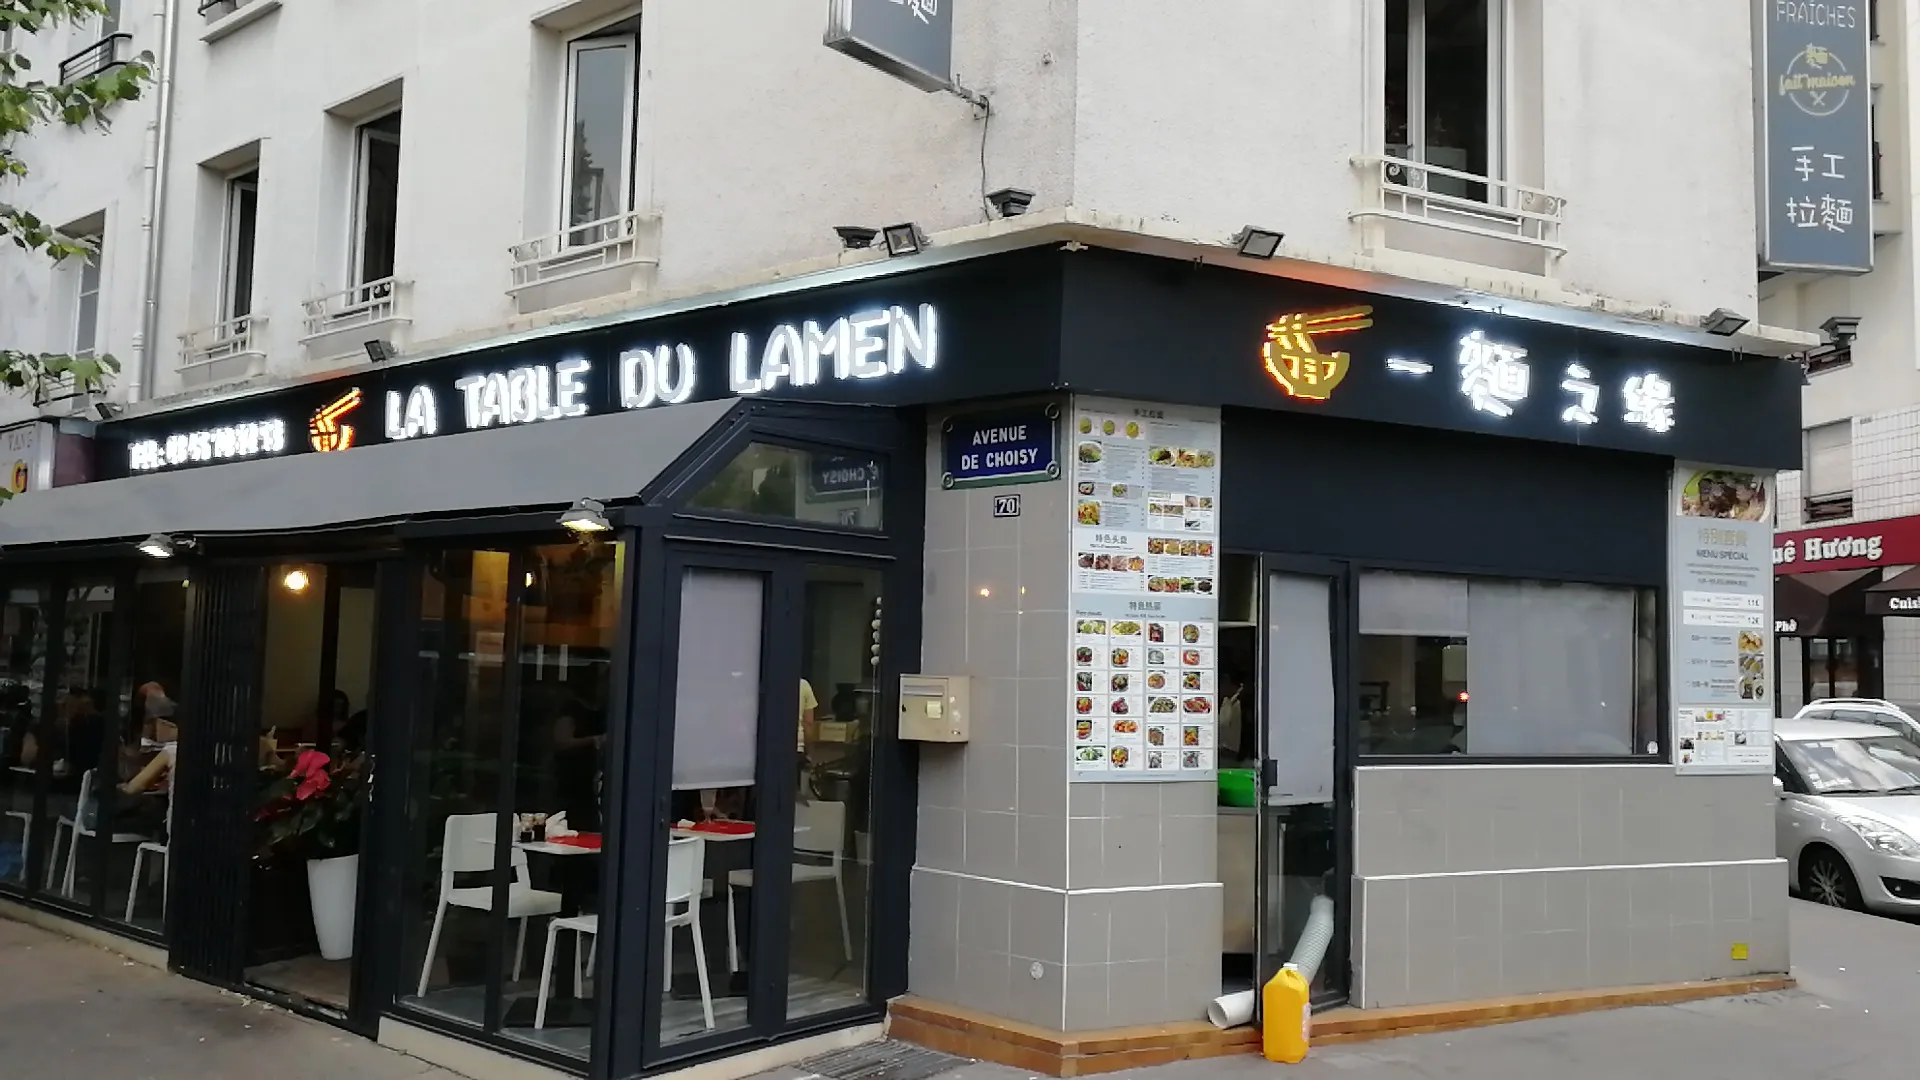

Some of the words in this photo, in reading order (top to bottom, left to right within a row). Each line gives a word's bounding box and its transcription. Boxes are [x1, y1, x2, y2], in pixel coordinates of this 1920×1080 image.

[1791, 145, 1845, 182] 手工
[1786, 193, 1853, 233] 拉麵
[384, 383, 437, 440] LA
[455, 359, 592, 430] TABLE
[619, 341, 696, 409] DU
[729, 302, 939, 395] LAMEN
[972, 425, 1027, 446] AVENUE
[961, 454, 979, 471] DE
[986, 447, 1039, 468] CHOISY
[998, 498, 1016, 514] 70
[1696, 548, 1718, 560] MENU
[1803, 535, 1884, 561] Hương
